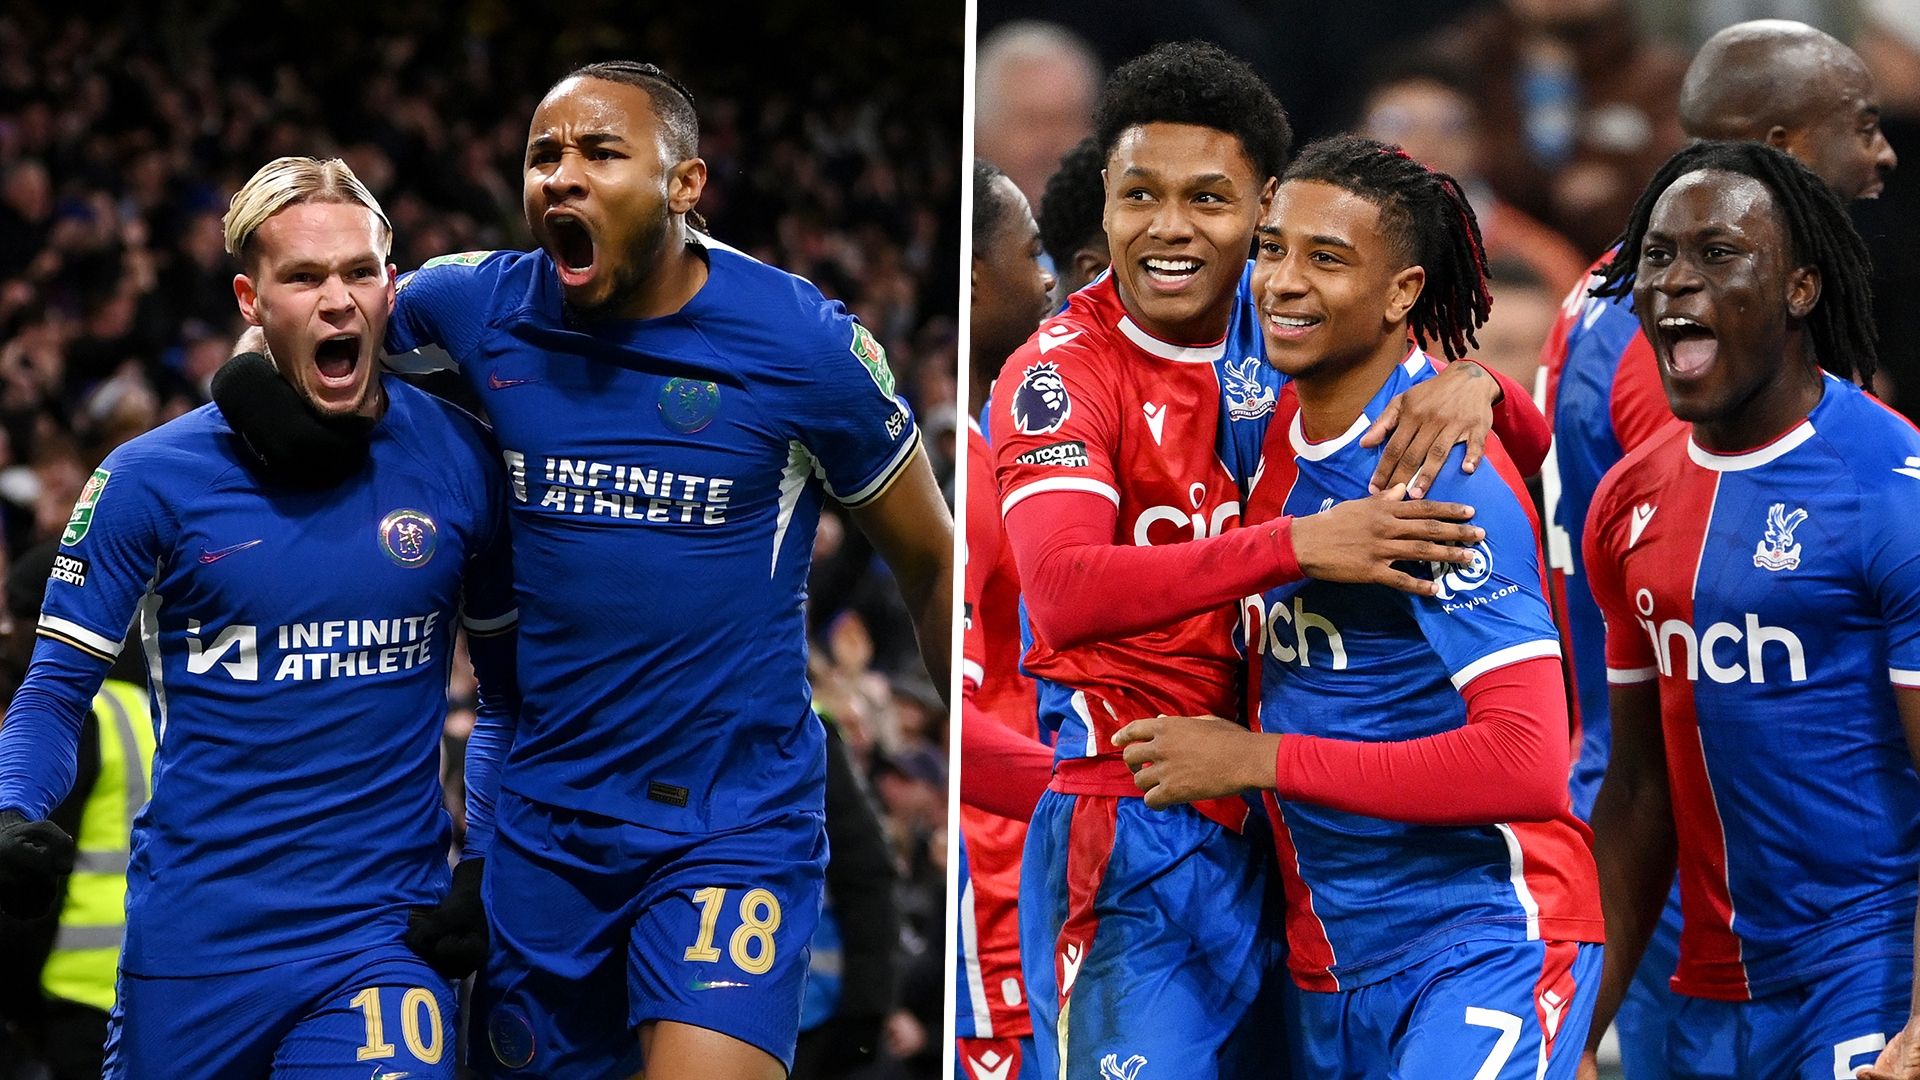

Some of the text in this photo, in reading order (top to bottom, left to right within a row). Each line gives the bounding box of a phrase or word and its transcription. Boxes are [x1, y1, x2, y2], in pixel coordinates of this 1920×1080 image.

[1035, 444, 1080, 463] room
[545, 457, 735, 504] INFINITE
[540, 485, 730, 526] ATHLETE
[277, 610, 441, 650] INFINITE
[274, 638, 431, 682] ATHLETE
[684, 886, 782, 975] 18
[350, 986, 444, 1065] 10
[1464, 1006, 1524, 1080] 7
